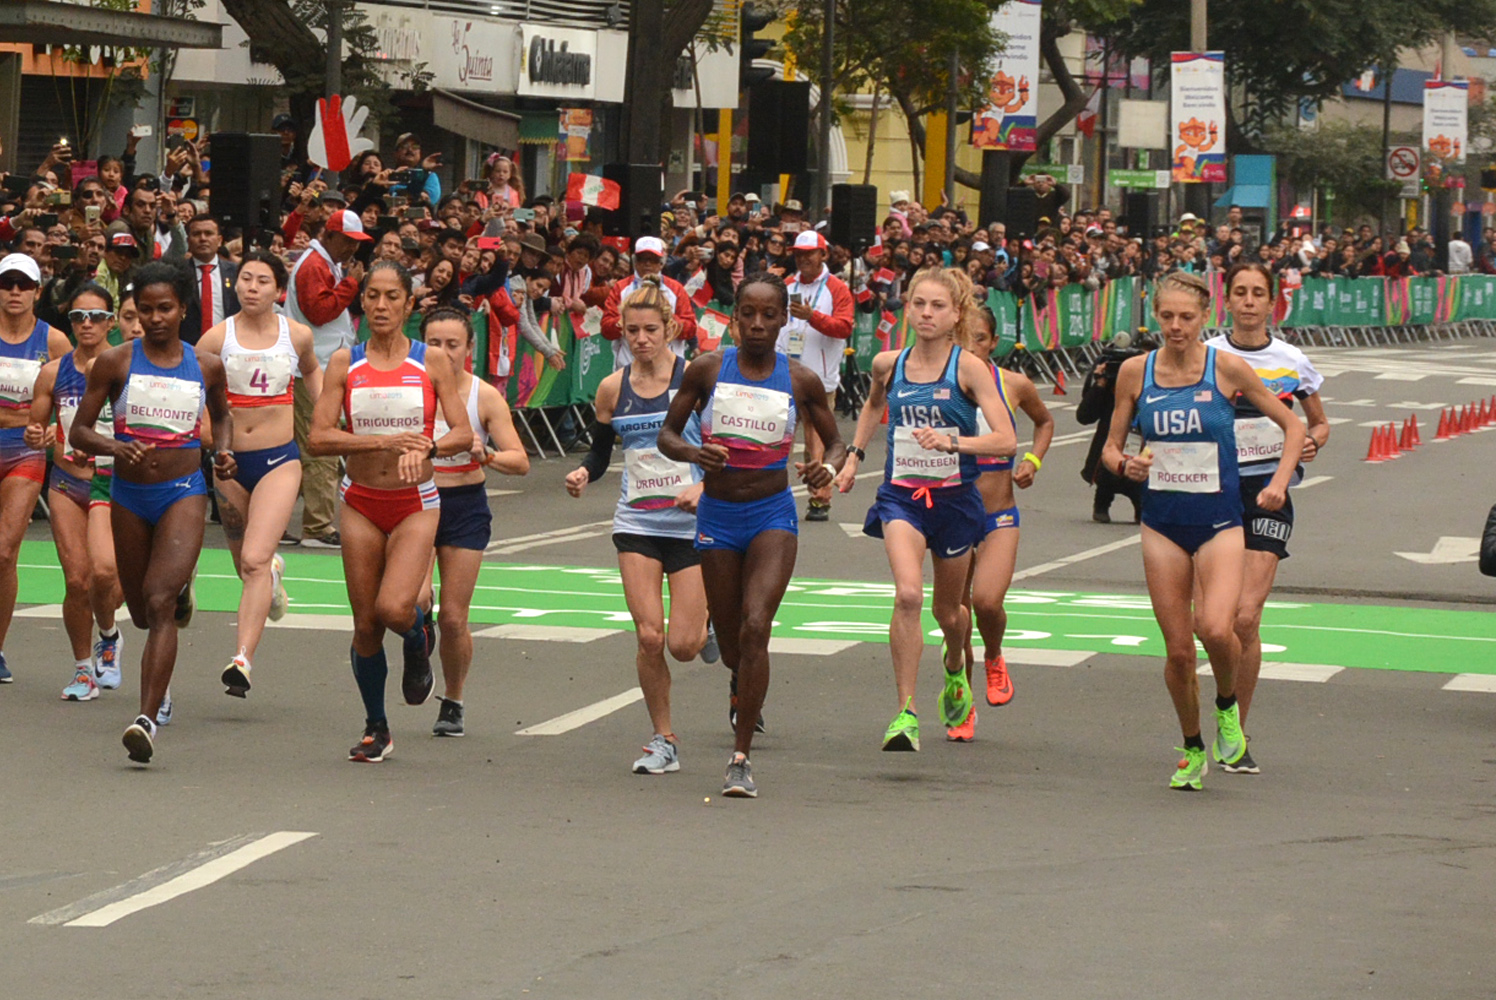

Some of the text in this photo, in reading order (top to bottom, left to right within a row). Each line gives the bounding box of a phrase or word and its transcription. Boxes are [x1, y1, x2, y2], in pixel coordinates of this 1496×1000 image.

[249, 368, 270, 394] 4
[131, 404, 194, 422] BELMONTE
[901, 405, 946, 428] USA
[355, 416, 420, 428] TRIGUEROS
[620, 420, 663, 432] ARGENT
[720, 414, 777, 432] CASTILLO
[1154, 408, 1202, 436] USA
[1236, 442, 1284, 457] ODRÍGUEZ
[895, 456, 957, 468] SACHTLEBEN
[636, 475, 682, 490] URRUTIA
[1157, 471, 1209, 483] ROECKER
[1252, 517, 1291, 542] VEN
